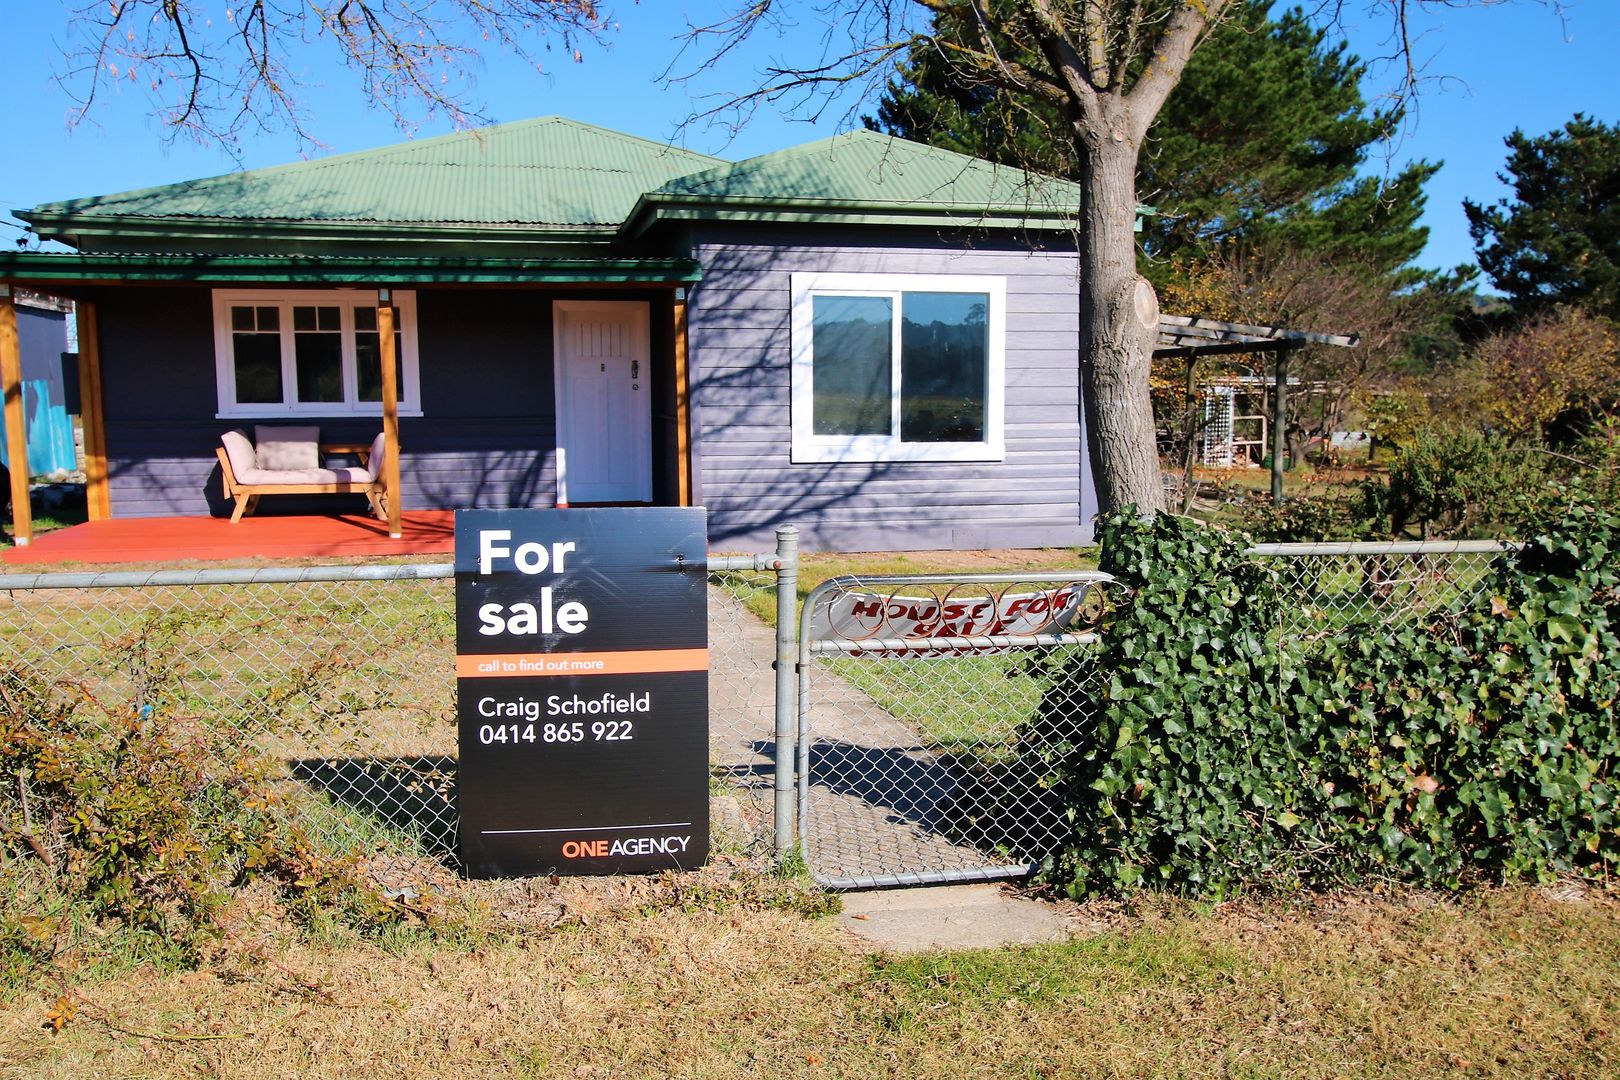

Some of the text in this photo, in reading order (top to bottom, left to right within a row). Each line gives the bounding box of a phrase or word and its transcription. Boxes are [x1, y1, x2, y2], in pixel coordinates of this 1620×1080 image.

[479, 529, 576, 575] For
[478, 587, 589, 636] sale
[851, 592, 1075, 621] HOUSE FOR
[478, 658, 605, 672] call to find out more
[478, 692, 651, 721] Craig Schofield
[480, 721, 633, 744] 0414 865 922
